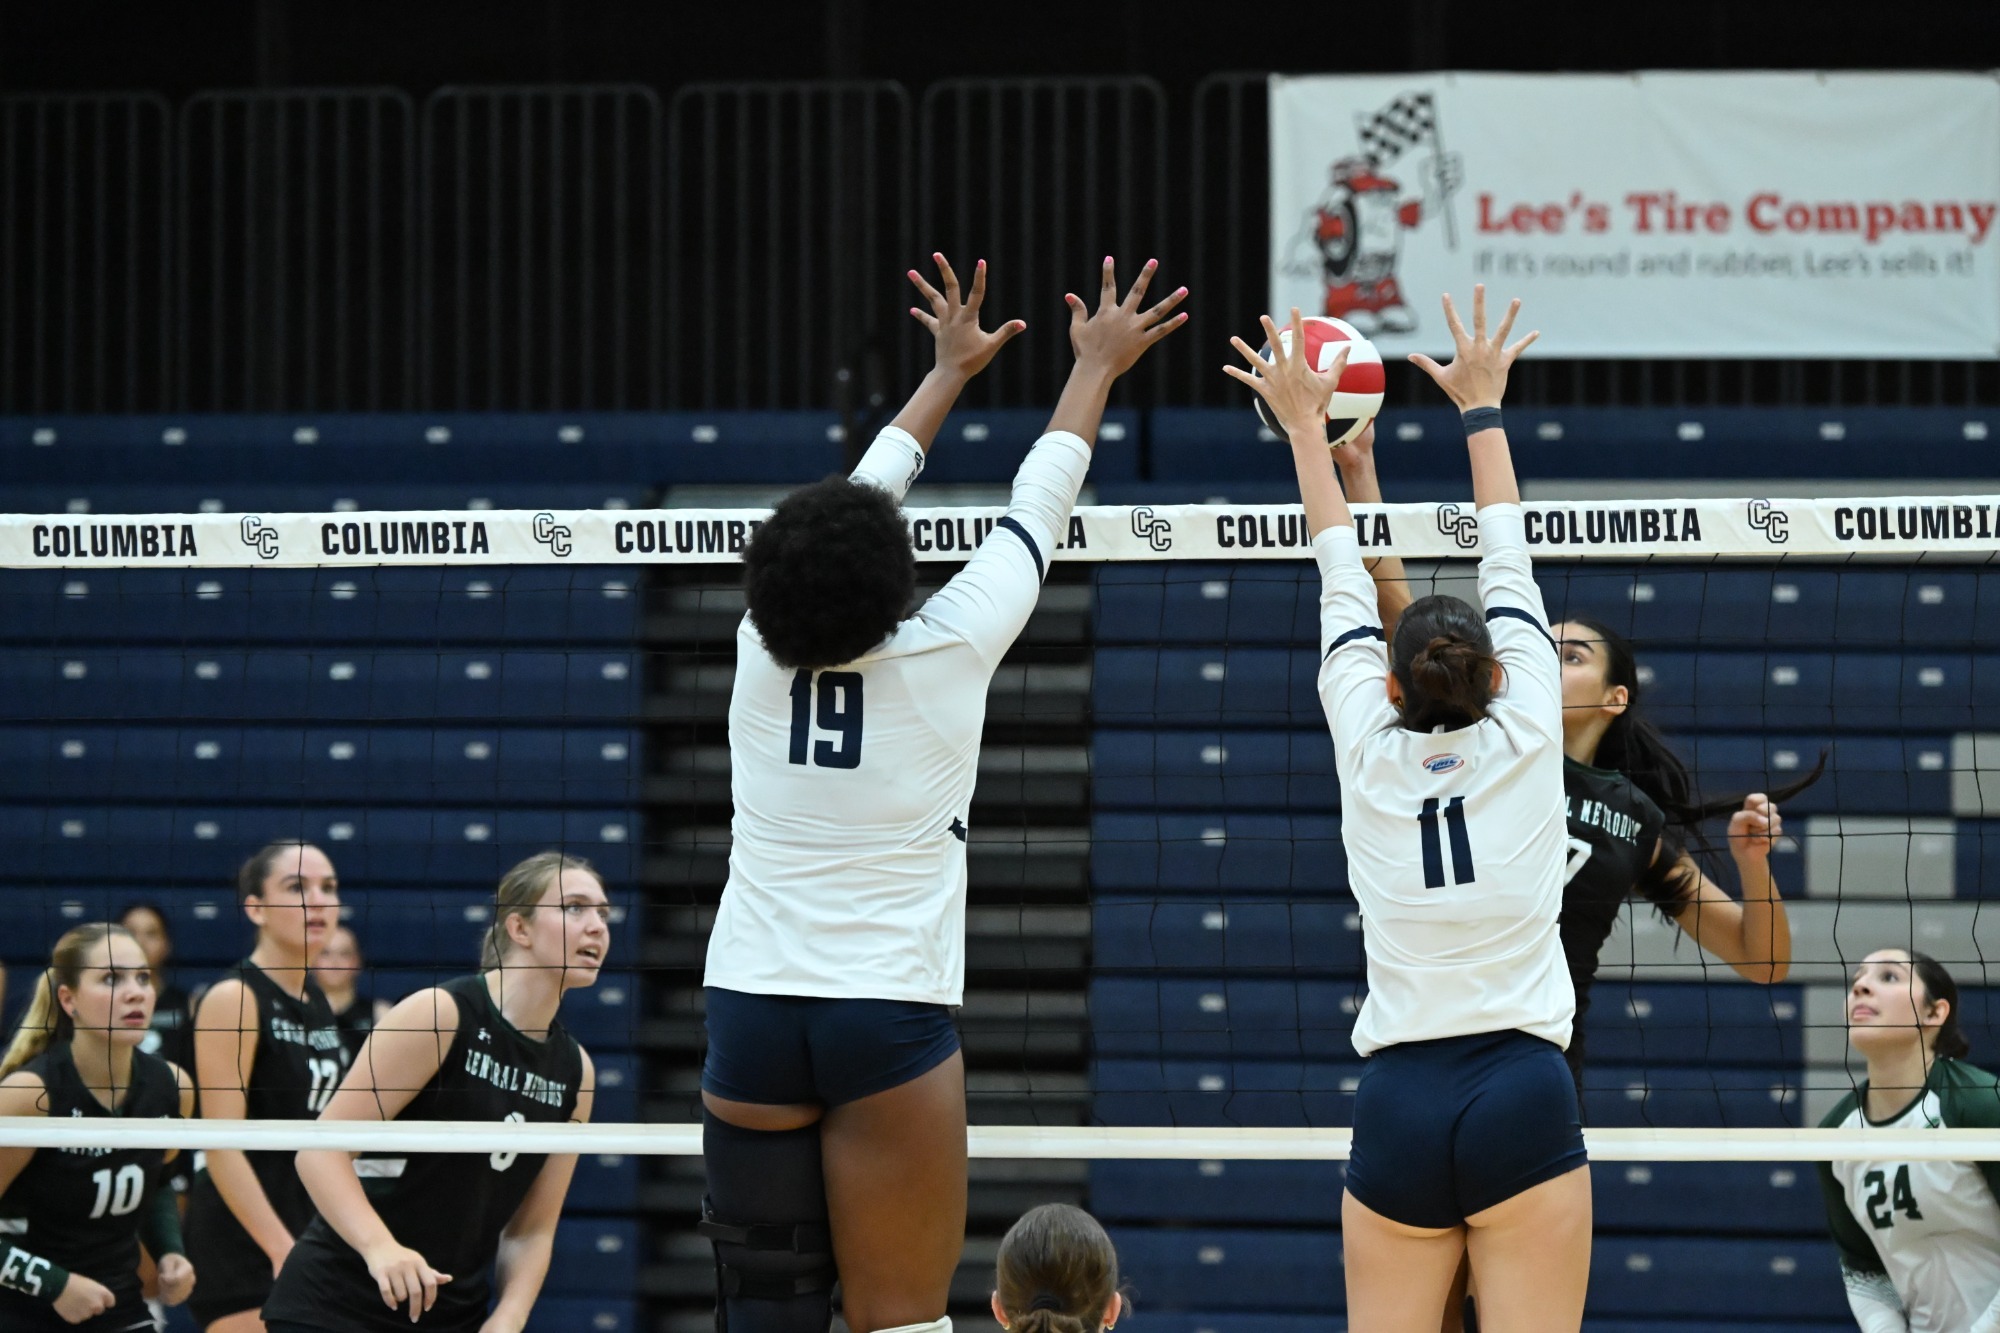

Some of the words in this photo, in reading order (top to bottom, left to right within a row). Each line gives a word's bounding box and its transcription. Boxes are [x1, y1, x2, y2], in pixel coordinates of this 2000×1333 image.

[1477, 189, 1611, 234] Lee's
[1624, 189, 1732, 234] Tire
[1746, 193, 1996, 244] Company
[1544, 250, 1630, 277] round
[1637, 250, 1692, 277] and
[33, 525, 198, 557] COLUMBIA
[240, 516, 279, 559] CC
[321, 521, 490, 555] COLUMBIA
[533, 513, 572, 557] CC
[913, 516, 1087, 551] COLUA
[1131, 507, 1172, 551] CC
[1217, 513, 1392, 548] COLUIA
[1437, 504, 1478, 549] CC
[1525, 508, 1702, 544] COLUMBIA
[1748, 499, 1789, 544] CC
[1834, 504, 2000, 540] COLUMBI
[789, 667, 864, 769] 19
[1417, 796, 1475, 889] 11
[89, 1164, 144, 1219] 10
[1864, 1165, 1923, 1231] 24
